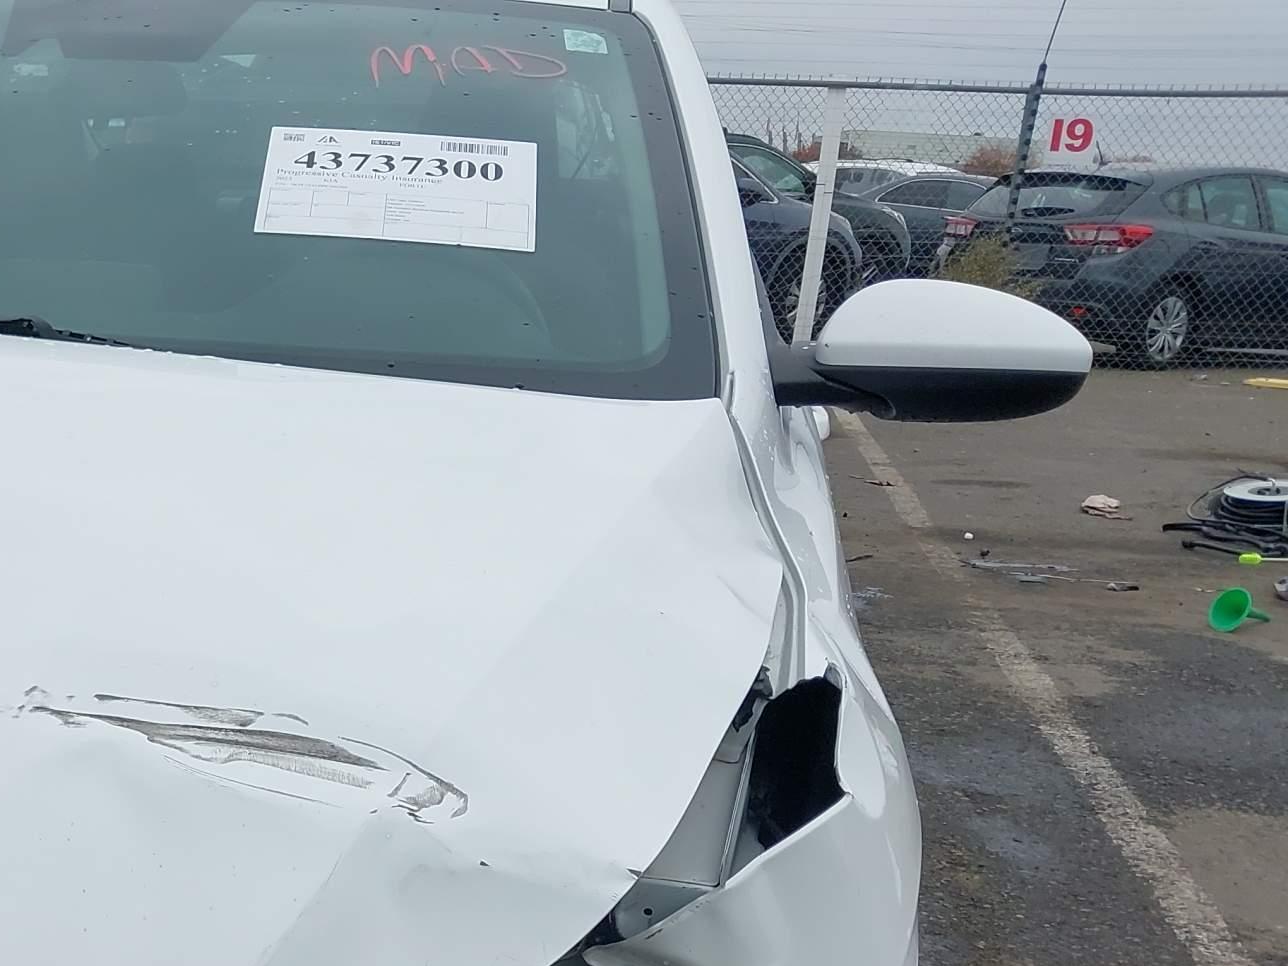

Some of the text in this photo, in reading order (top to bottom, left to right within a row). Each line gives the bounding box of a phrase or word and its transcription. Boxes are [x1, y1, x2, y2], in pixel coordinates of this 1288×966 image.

[1050, 118, 1094, 152] 19
[277, 168, 444, 185] Progressive Casualty Insurance
[294, 150, 503, 181] 43737300
